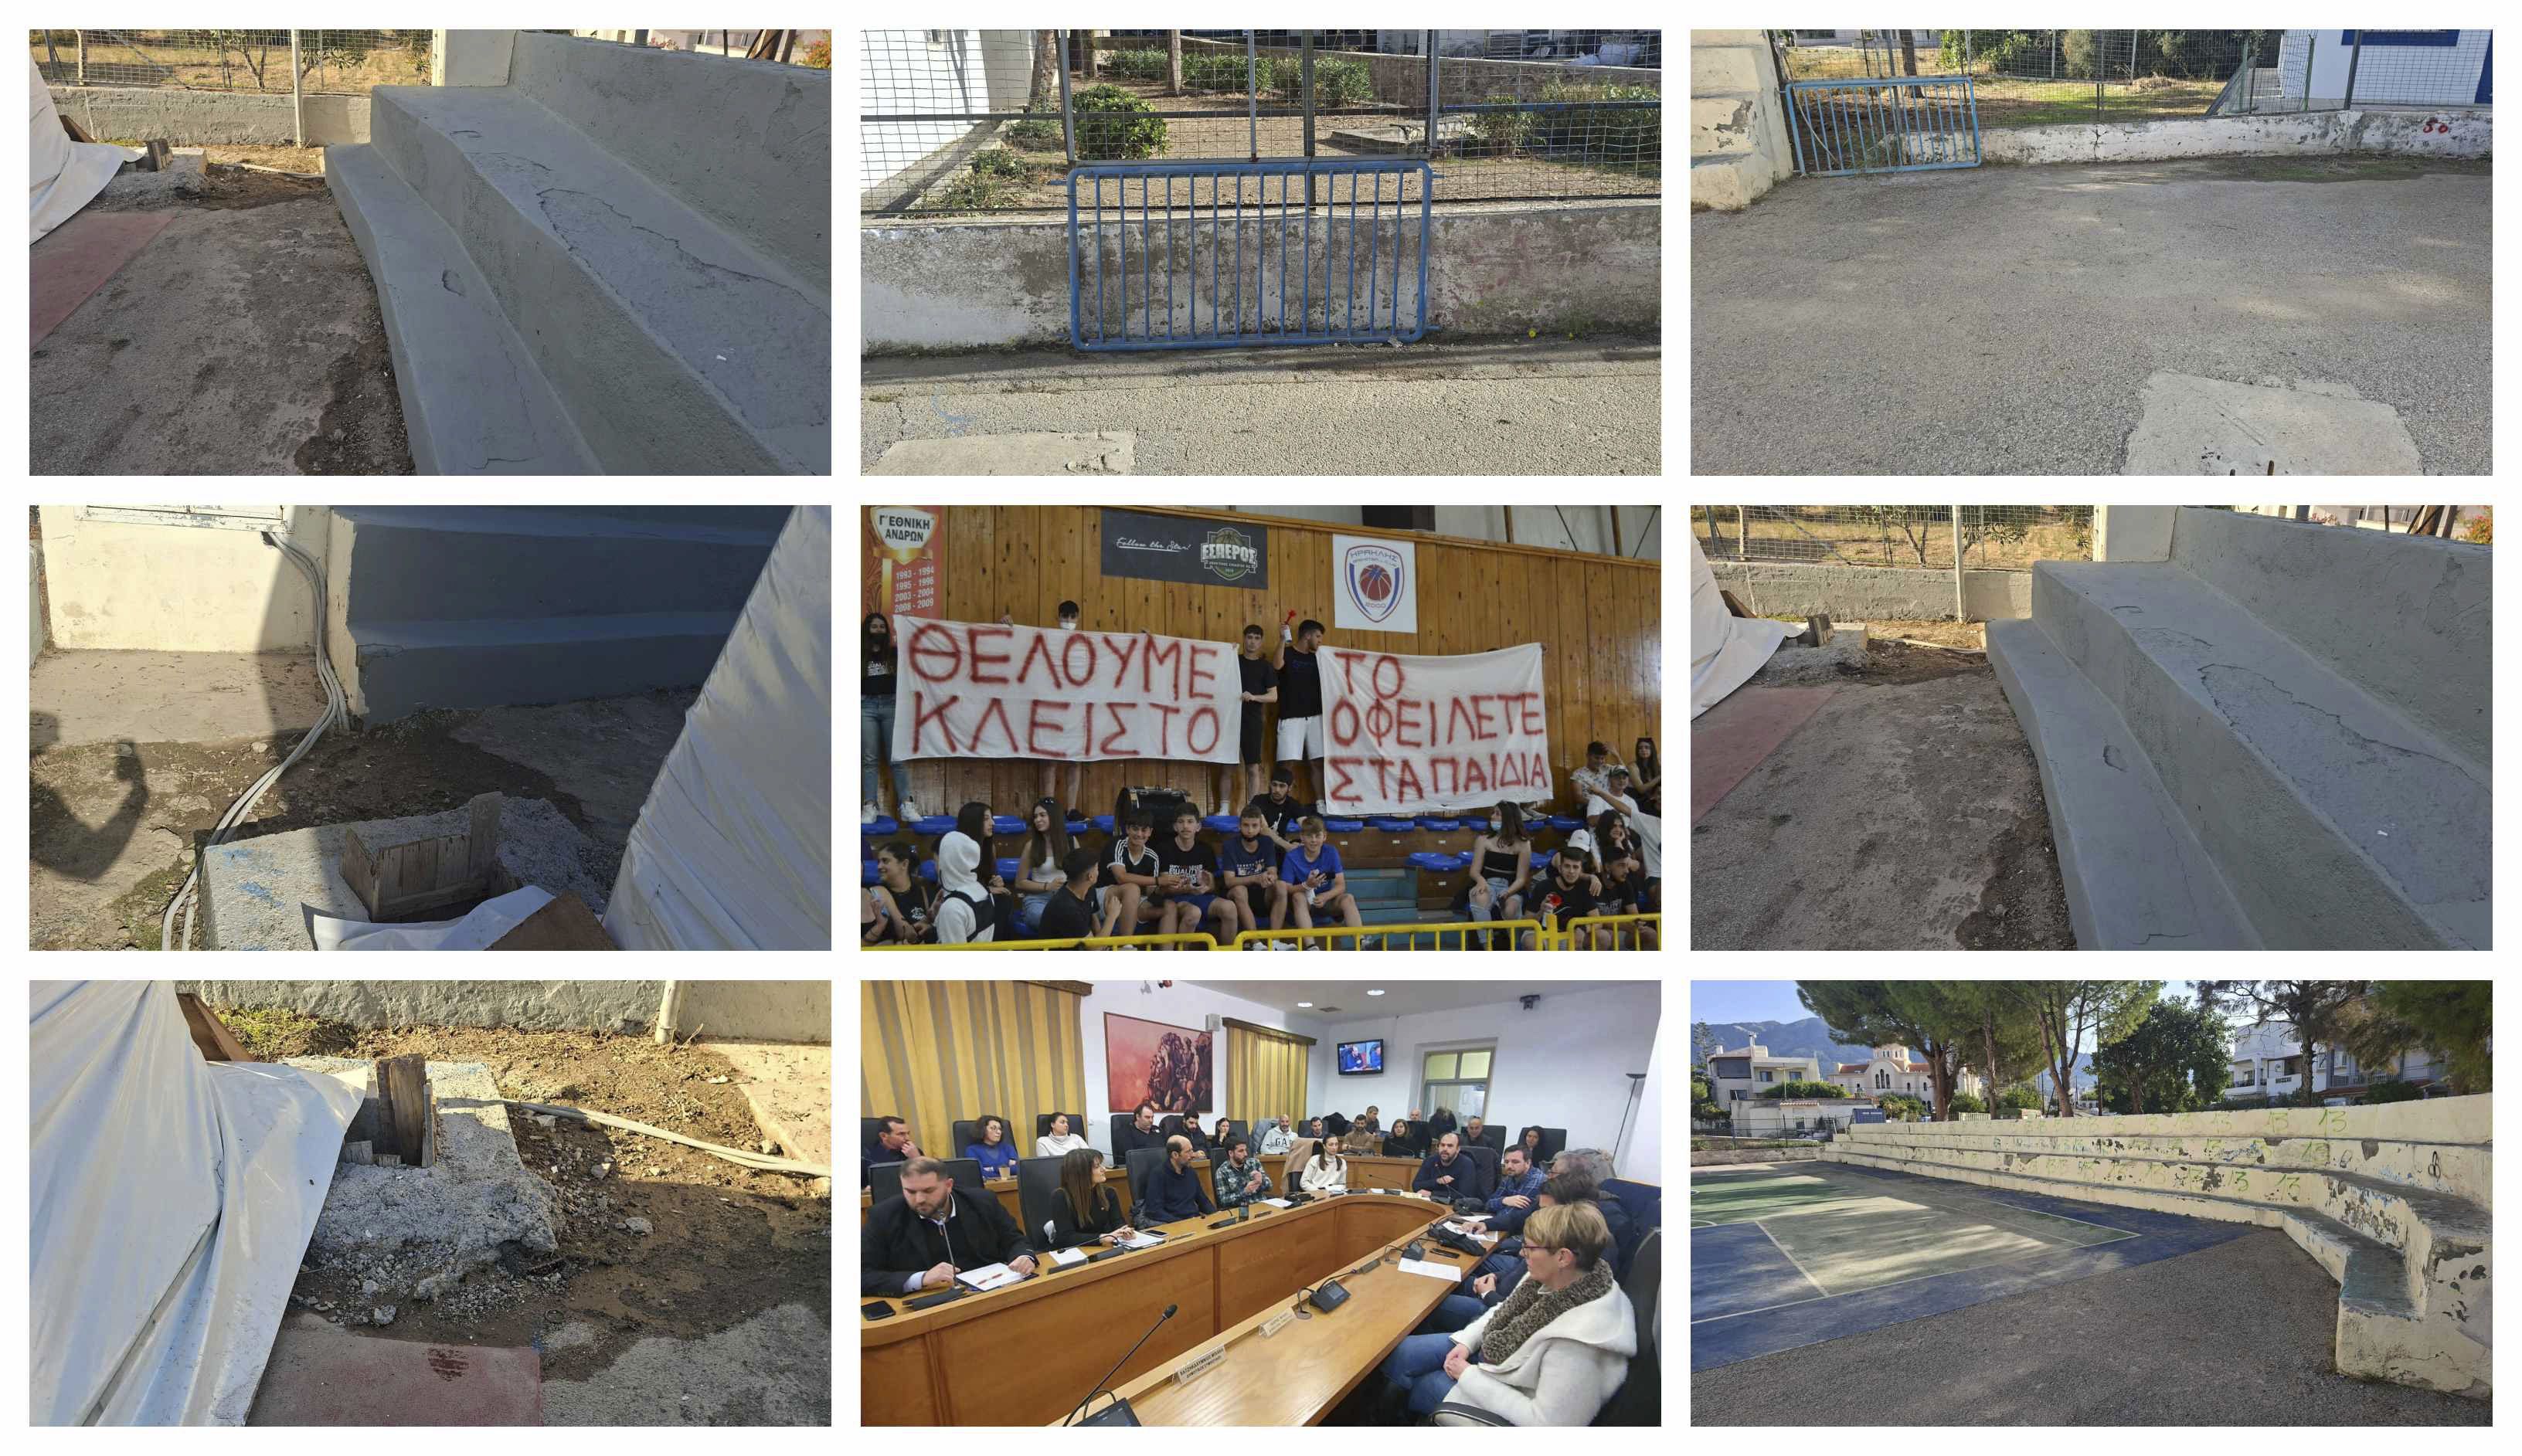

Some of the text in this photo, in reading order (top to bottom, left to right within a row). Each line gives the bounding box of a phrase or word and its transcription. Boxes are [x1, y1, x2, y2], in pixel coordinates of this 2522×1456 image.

[885, 529, 923, 541] ΑΝΔΡΩΝ
[1202, 543, 1256, 565] ΕΣΠΕΡΟΣ
[896, 570, 912, 580] 1993
[919, 567, 934, 576] 1994
[909, 623, 1219, 701] ΘΕΛΟΥΜΕ
[1334, 652, 1405, 700] ΤΟ
[913, 690, 1220, 758] ΚΛΕΙΣΤΟ
[1331, 692, 1545, 748] ΟΦΕΙΛΕΤΕ
[2318, 1109, 2347, 1136] 13
